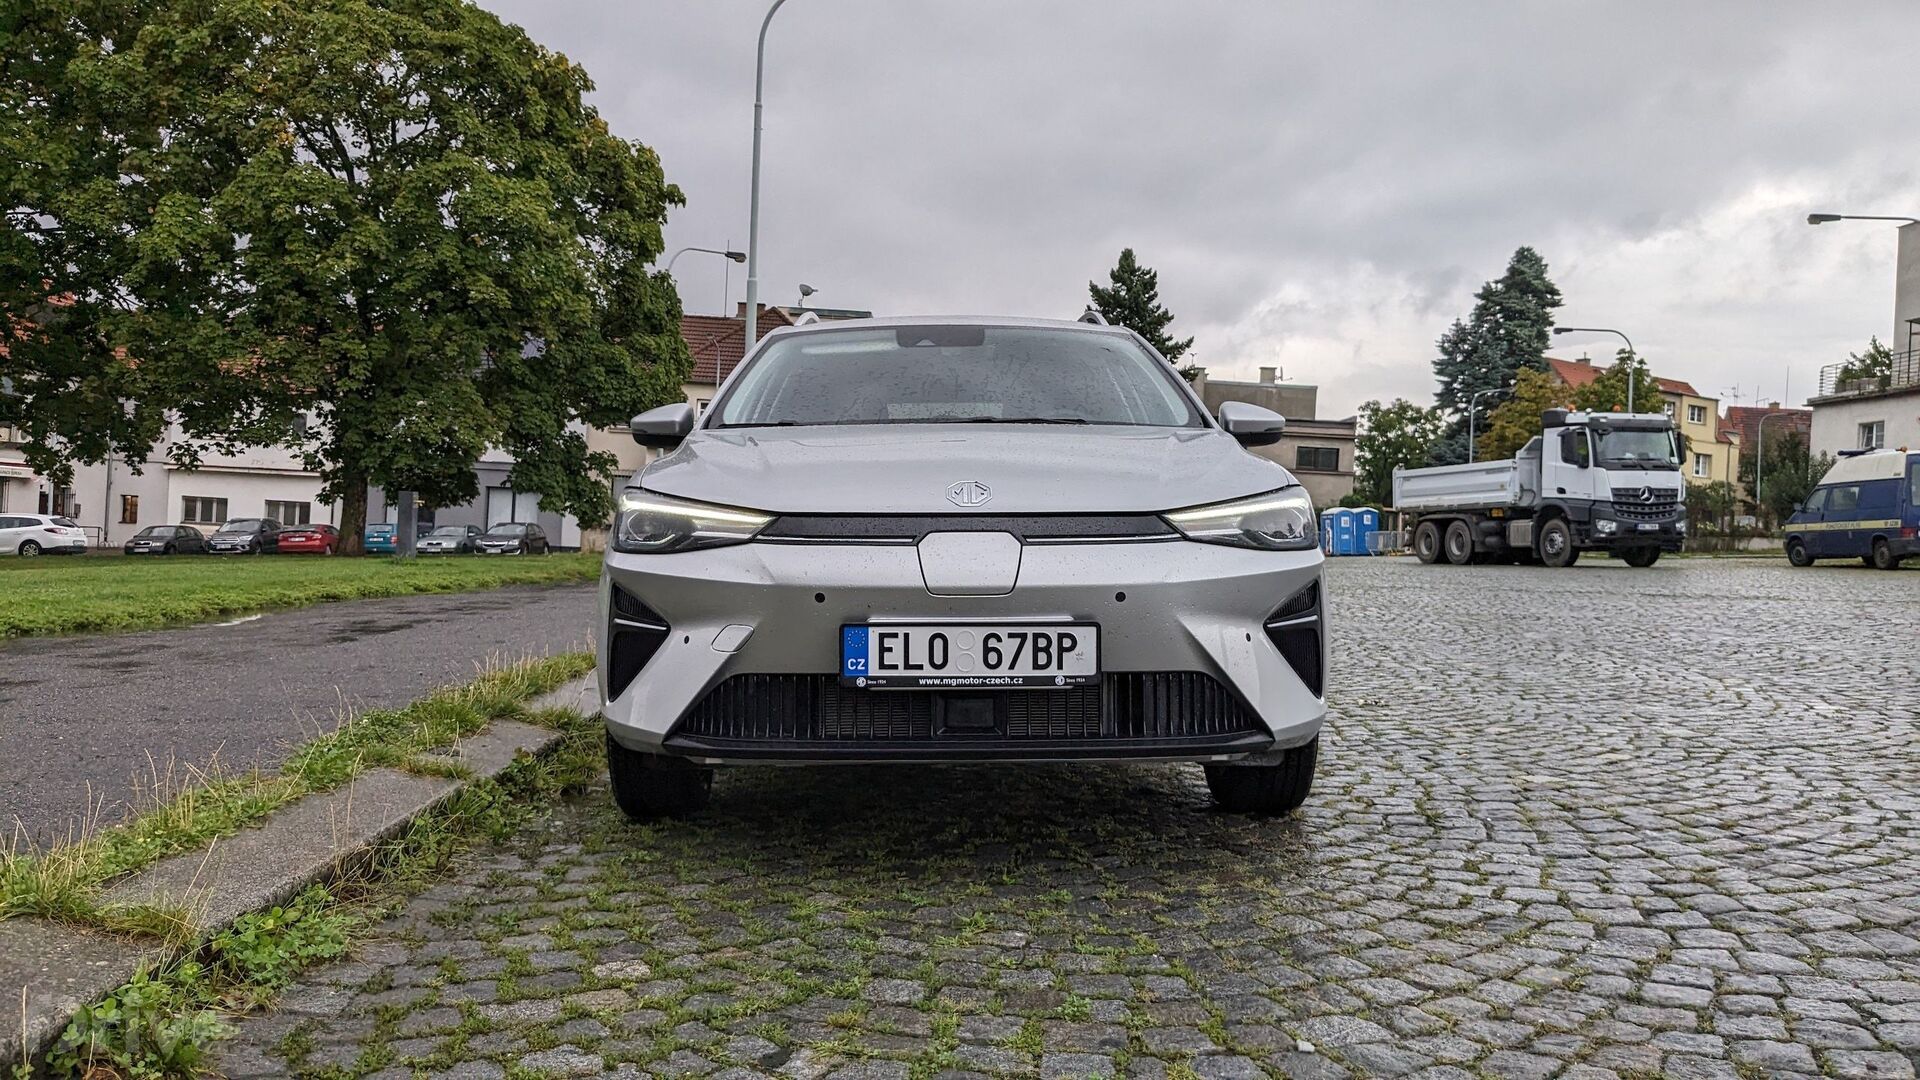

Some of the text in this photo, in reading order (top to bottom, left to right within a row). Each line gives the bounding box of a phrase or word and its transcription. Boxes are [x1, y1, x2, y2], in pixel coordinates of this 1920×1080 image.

[950, 483, 989, 504] MG
[982, 632, 1078, 670] 67BP
[847, 658, 865, 670] CZ
[918, 676, 1024, 686] www.mgmotor-czech.cz
